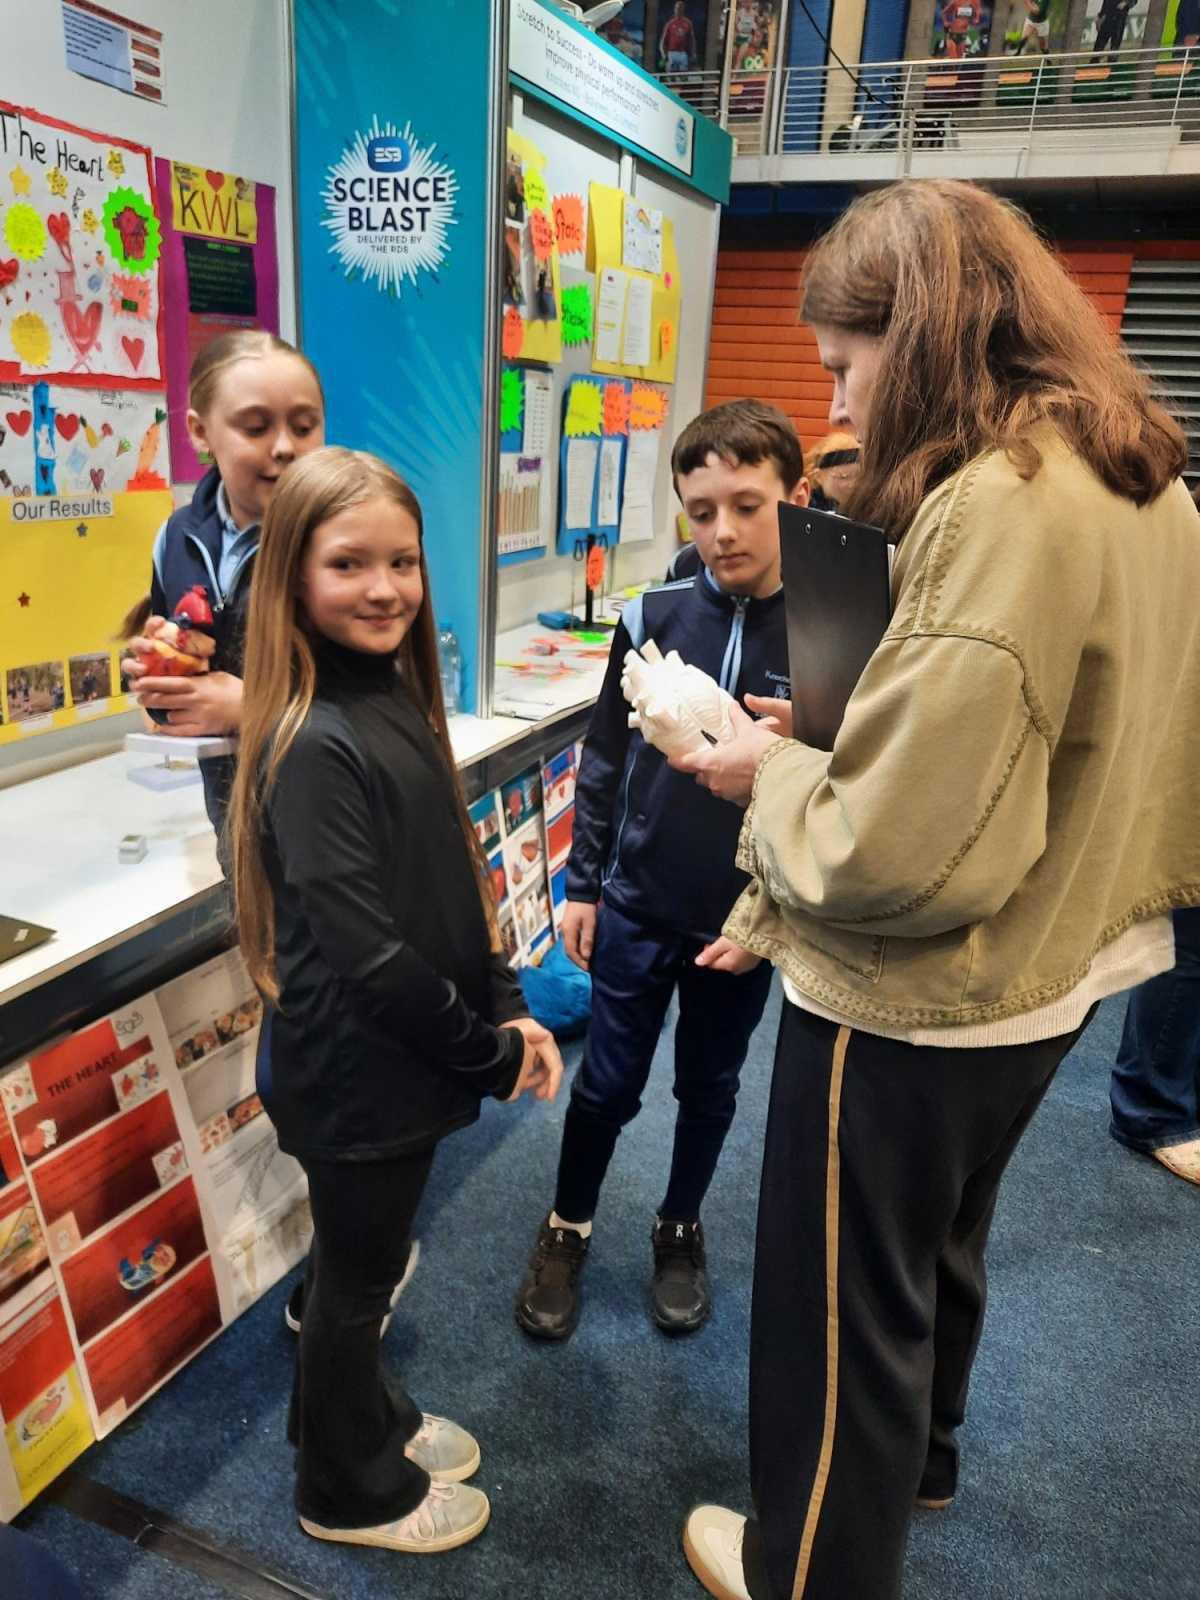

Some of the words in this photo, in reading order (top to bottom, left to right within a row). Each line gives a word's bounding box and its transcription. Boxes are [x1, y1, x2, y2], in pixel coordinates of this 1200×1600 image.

[517, 3, 546, 33] Stretch
[546, 26, 555, 41] to
[556, 30, 583, 59] Success
[0, 110, 48, 164] The
[57, 138, 105, 182] Heart
[374, 147, 402, 162] ESB
[176, 177, 249, 239] KWL
[349, 207, 431, 232] BLAST
[357, 235, 407, 244] DELIVERED
[410, 235, 422, 244] BY
[371, 245, 388, 254] THE
[391, 245, 409, 254] RDS
[12, 502, 45, 521] Our
[50, 499, 111, 518] Results
[47, 1076, 72, 1097] THE
[75, 1051, 117, 1083] HEART
